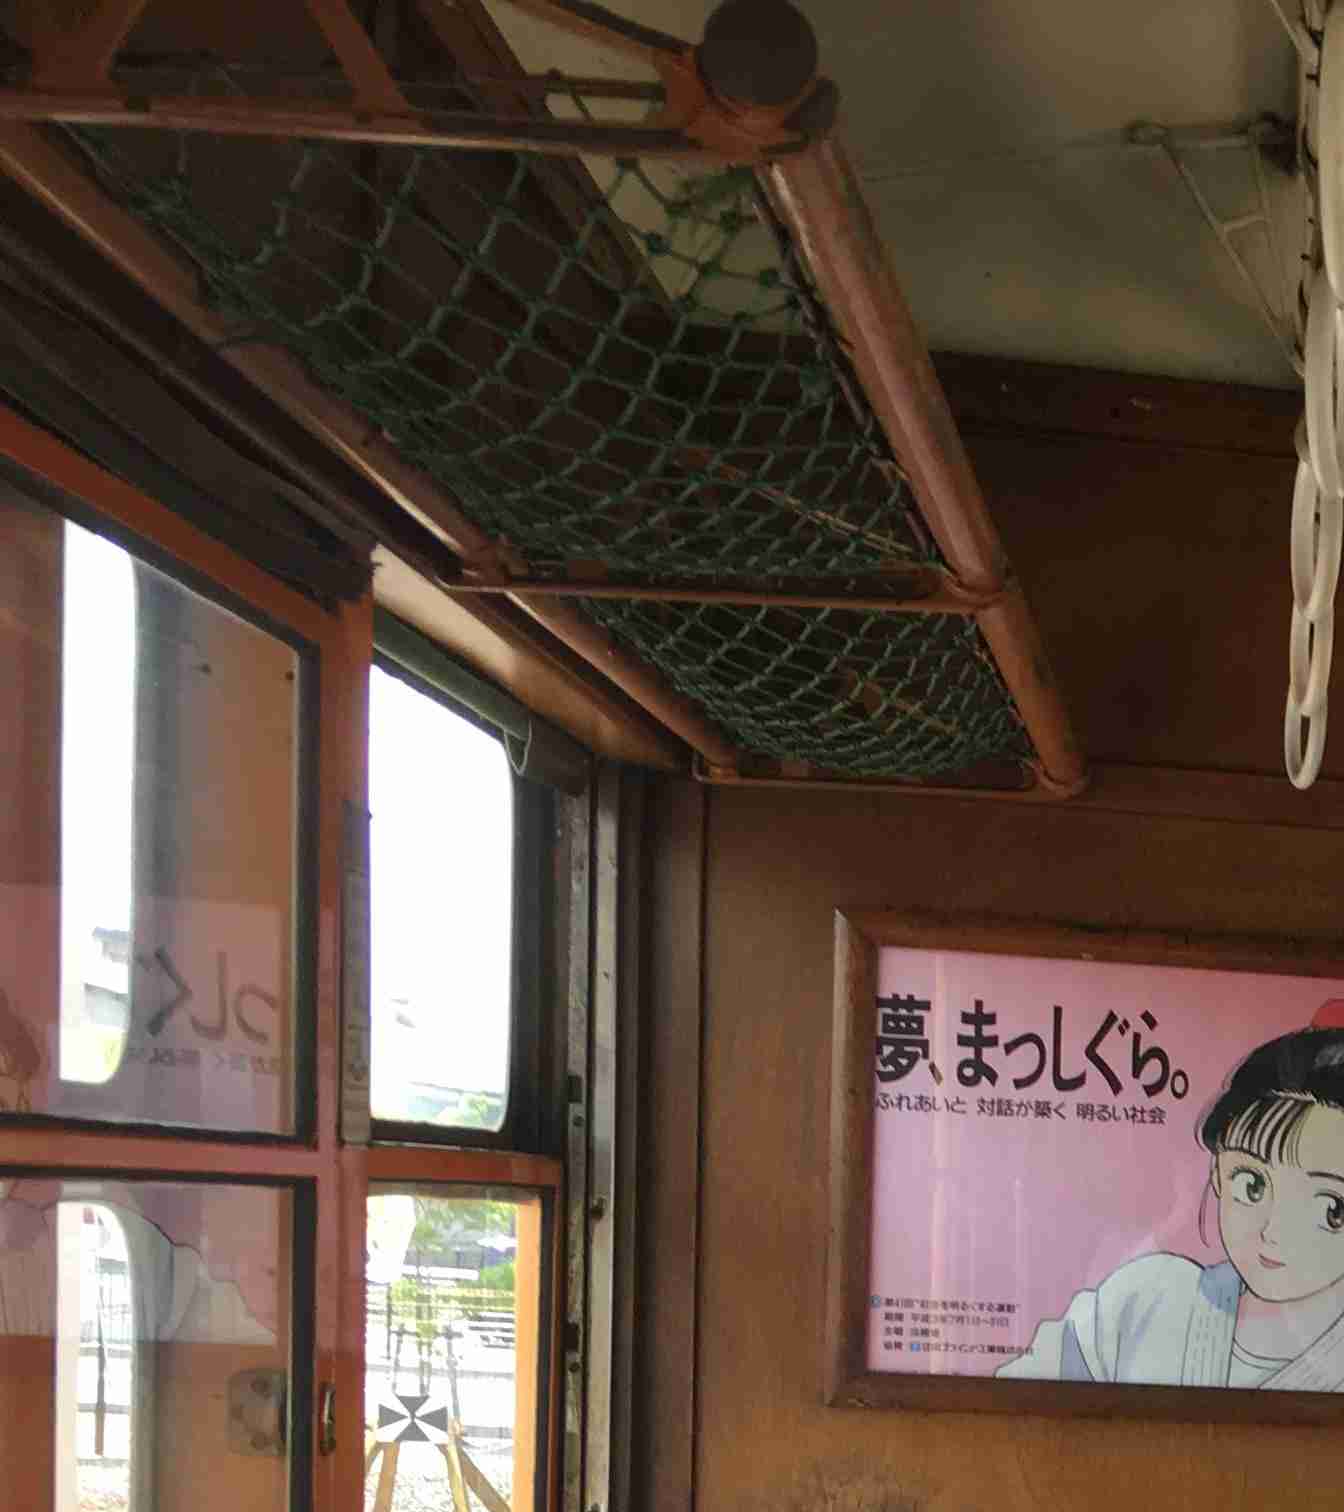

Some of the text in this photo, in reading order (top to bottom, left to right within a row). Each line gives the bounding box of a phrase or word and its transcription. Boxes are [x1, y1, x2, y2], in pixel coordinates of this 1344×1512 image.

[876, 1092, 968, 1116] ふれあいと
[1075, 1101, 1167, 1126] 明るい社会
